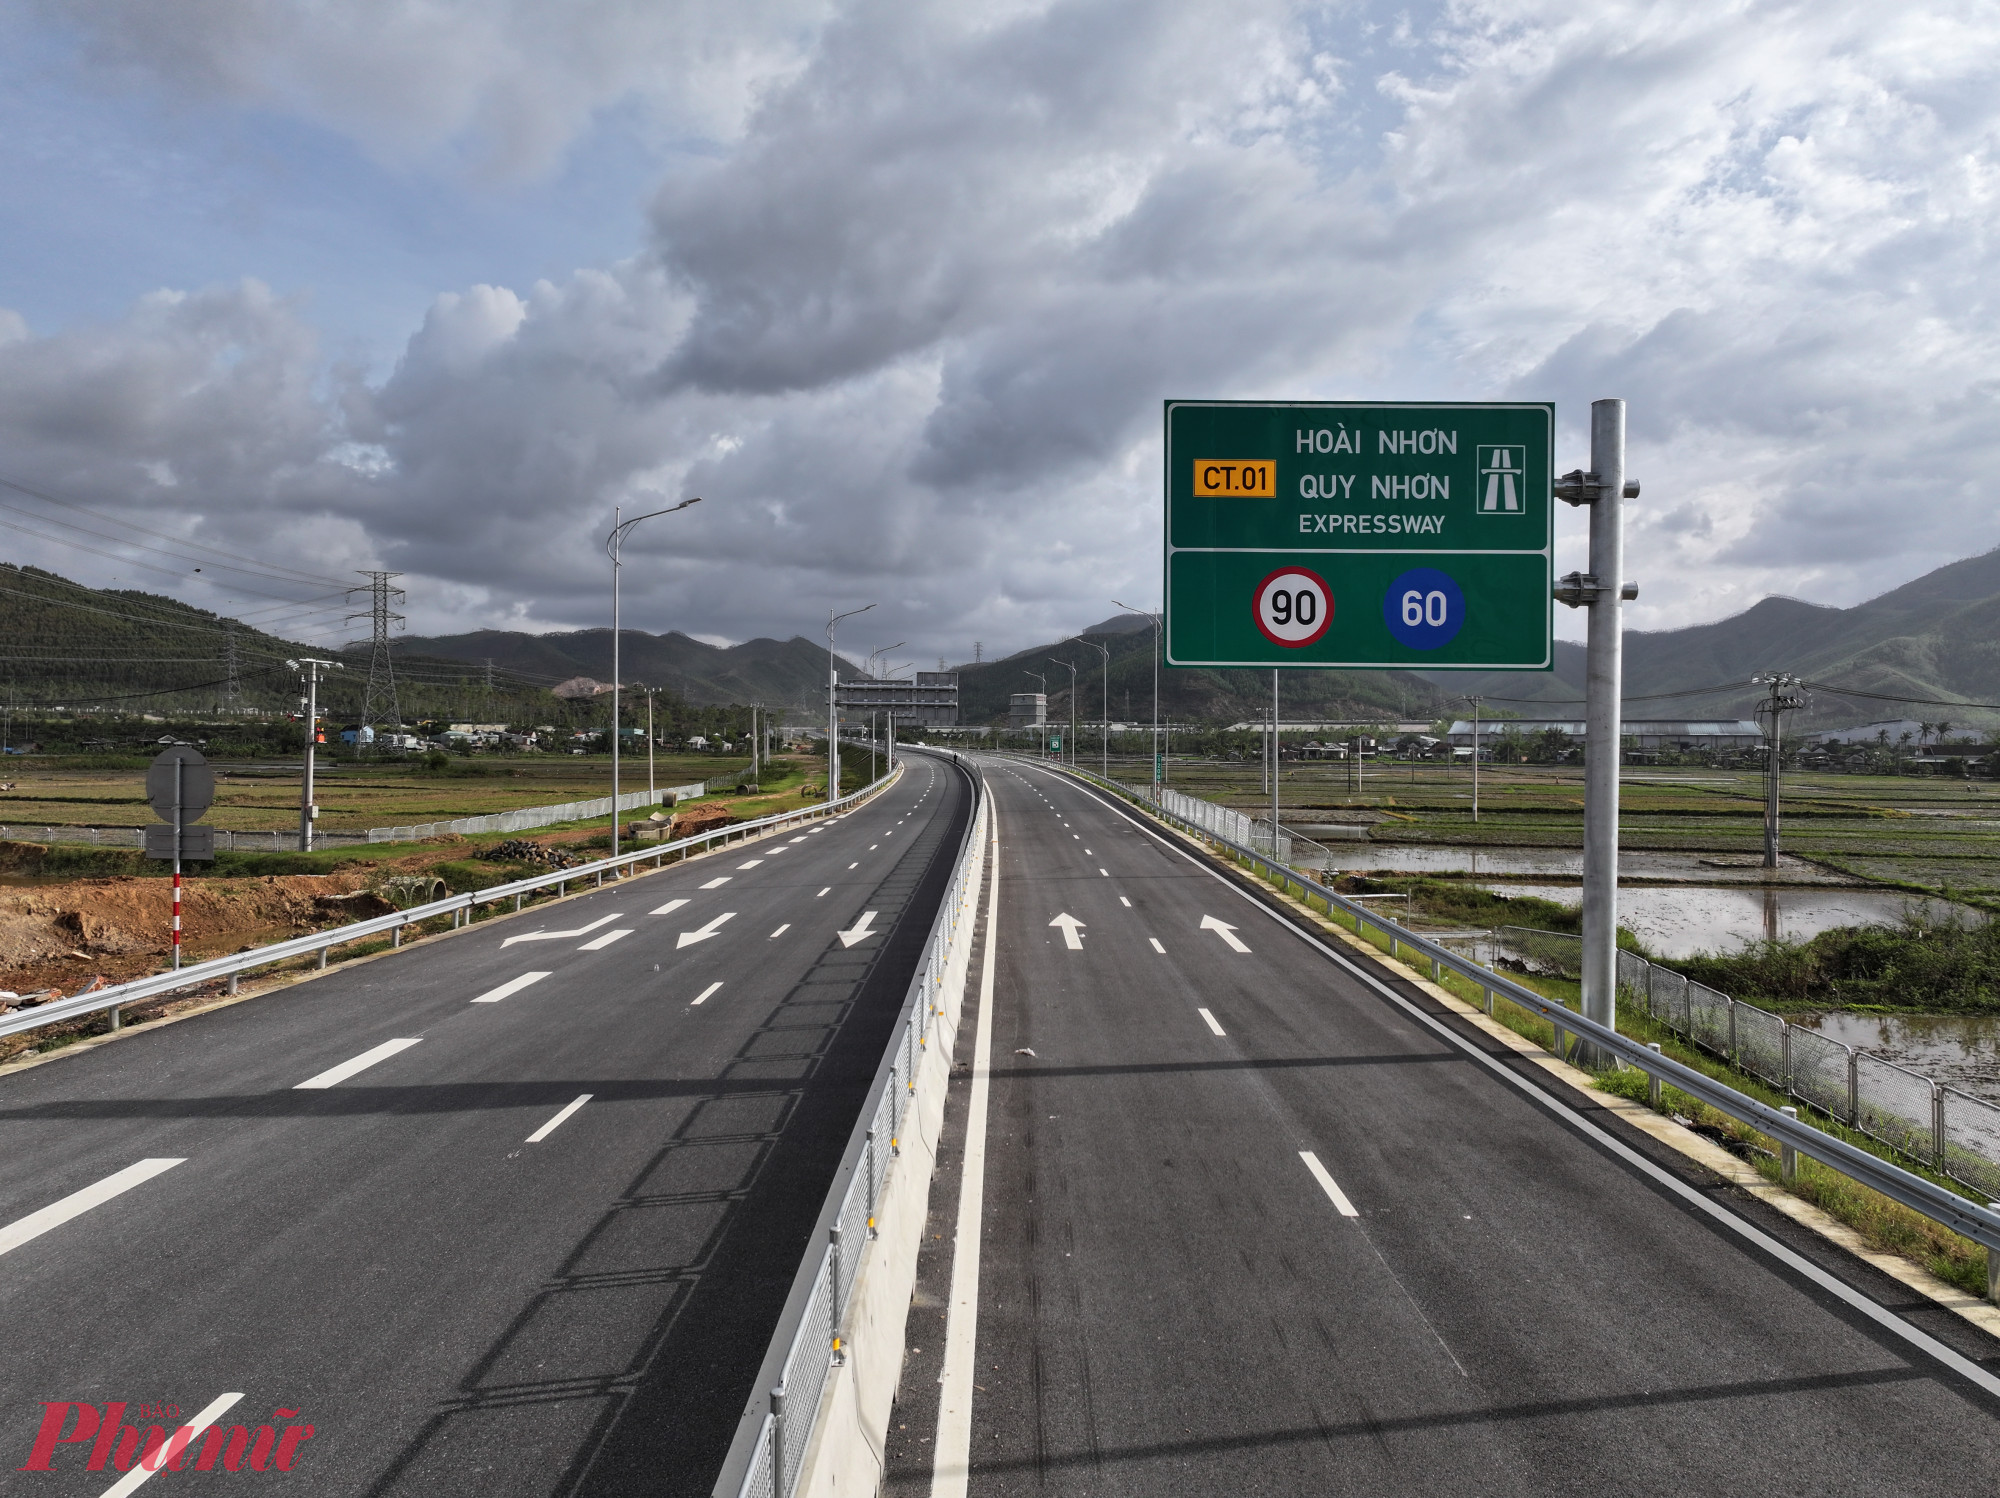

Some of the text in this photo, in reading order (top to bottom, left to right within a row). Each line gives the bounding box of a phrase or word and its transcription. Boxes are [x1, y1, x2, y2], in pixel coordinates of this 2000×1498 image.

[1297, 423, 1457, 455] HOÀI NHƠN
[1203, 467, 1266, 490] CT.01
[1300, 473, 1450, 499] QUY NHƠN
[1299, 515, 1446, 533] EXPRESSWAY
[1271, 590, 1316, 625] 90
[1403, 590, 1447, 626] 60
